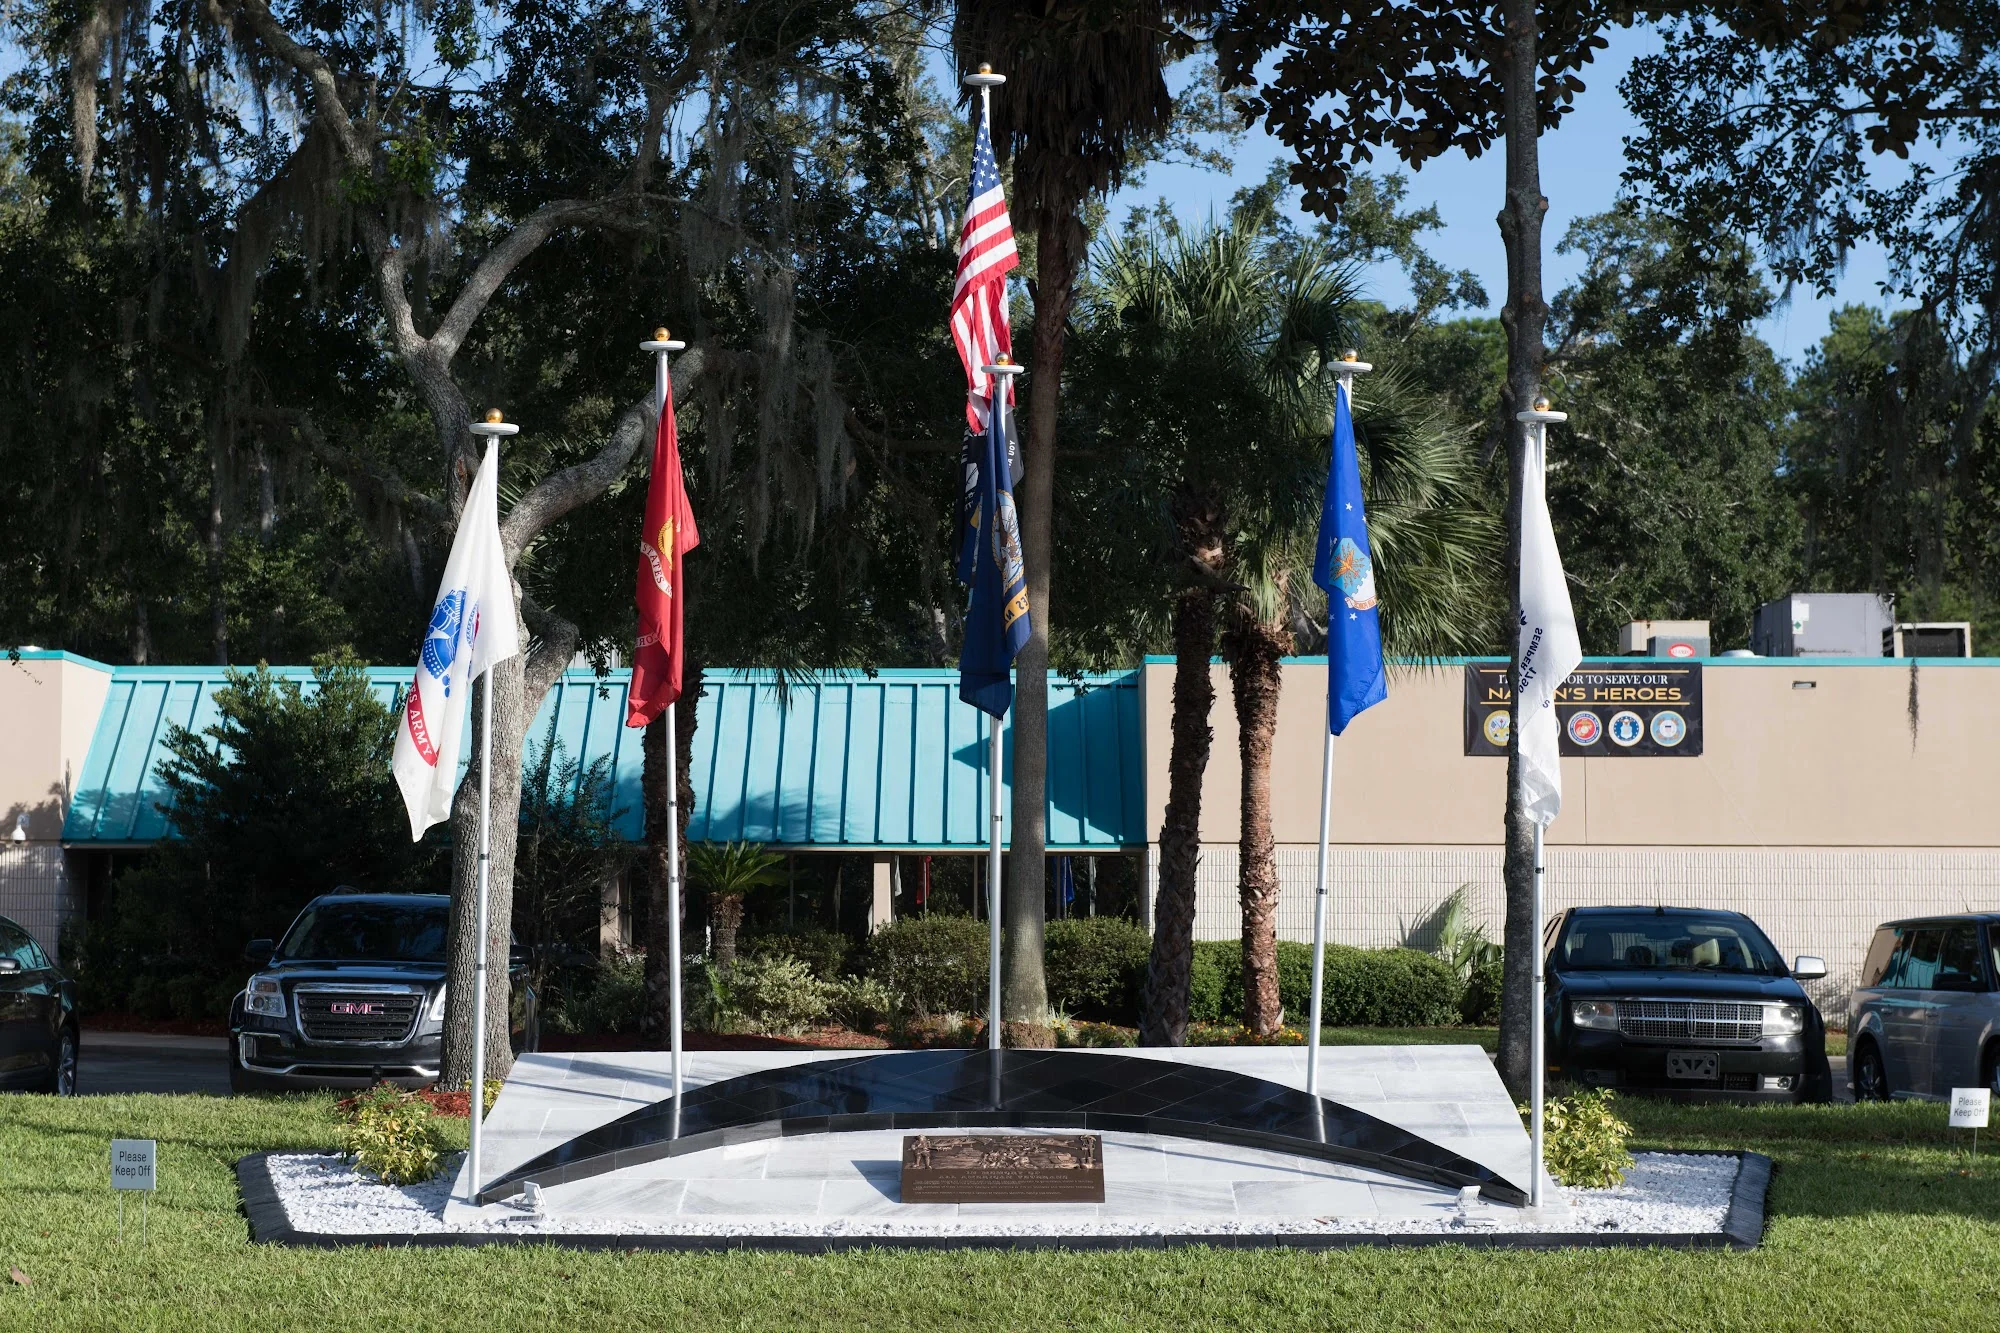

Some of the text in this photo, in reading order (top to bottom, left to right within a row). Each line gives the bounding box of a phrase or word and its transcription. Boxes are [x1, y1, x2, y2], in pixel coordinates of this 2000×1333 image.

[642, 543, 664, 584] STATES
[1586, 674, 1603, 684] TO
[1605, 674, 1641, 684] SERVE
[1642, 674, 1668, 684] OUR
[1593, 687, 1682, 700] HEROES
[410, 709, 432, 756] ARMY
[330, 1002, 384, 1015] GMC
[1958, 1097, 1982, 1106] Please
[1953, 1107, 1985, 1118] Keep Off
[119, 1150, 147, 1162] Please
[115, 1165, 151, 1179] Keep Off
